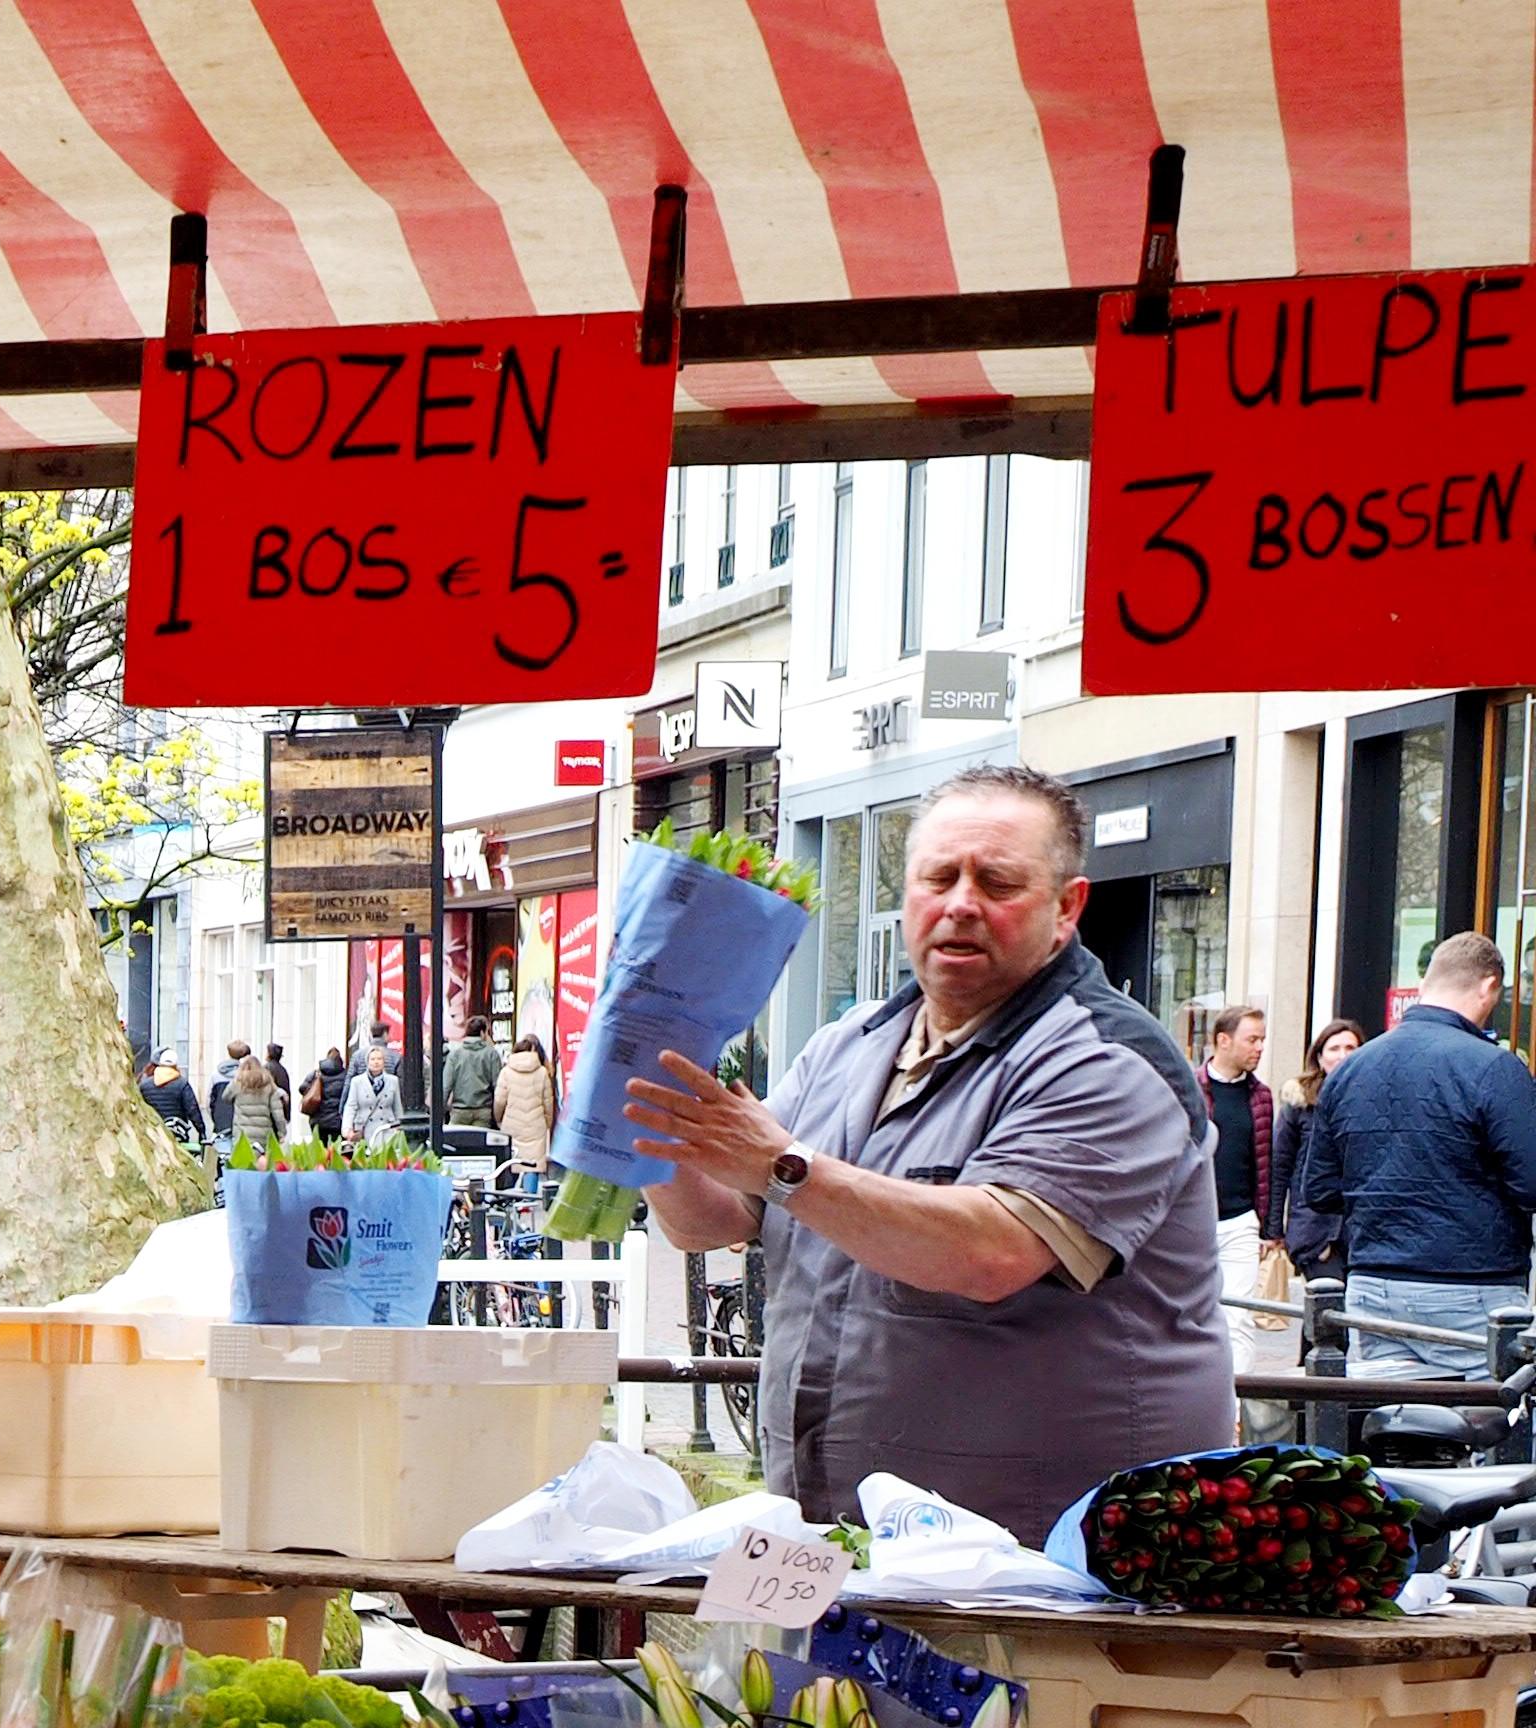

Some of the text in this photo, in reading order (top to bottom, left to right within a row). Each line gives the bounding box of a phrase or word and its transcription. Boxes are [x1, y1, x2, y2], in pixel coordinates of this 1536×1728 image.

[171, 345, 562, 466] ROZEN
[1117, 458, 1526, 646] 3 BOSSEN
[154, 514, 192, 636] 1
[248, 525, 411, 600] BOS
[931, 690, 1000, 709] ESPRIT
[272, 811, 429, 837] BROADWAY
[315, 895, 389, 908] JUICY STEAKS
[314, 910, 389, 923] FAMOUS RIBS
[357, 1218, 393, 1238] Smit
[743, 1531, 834, 1574] 10 VOOR
